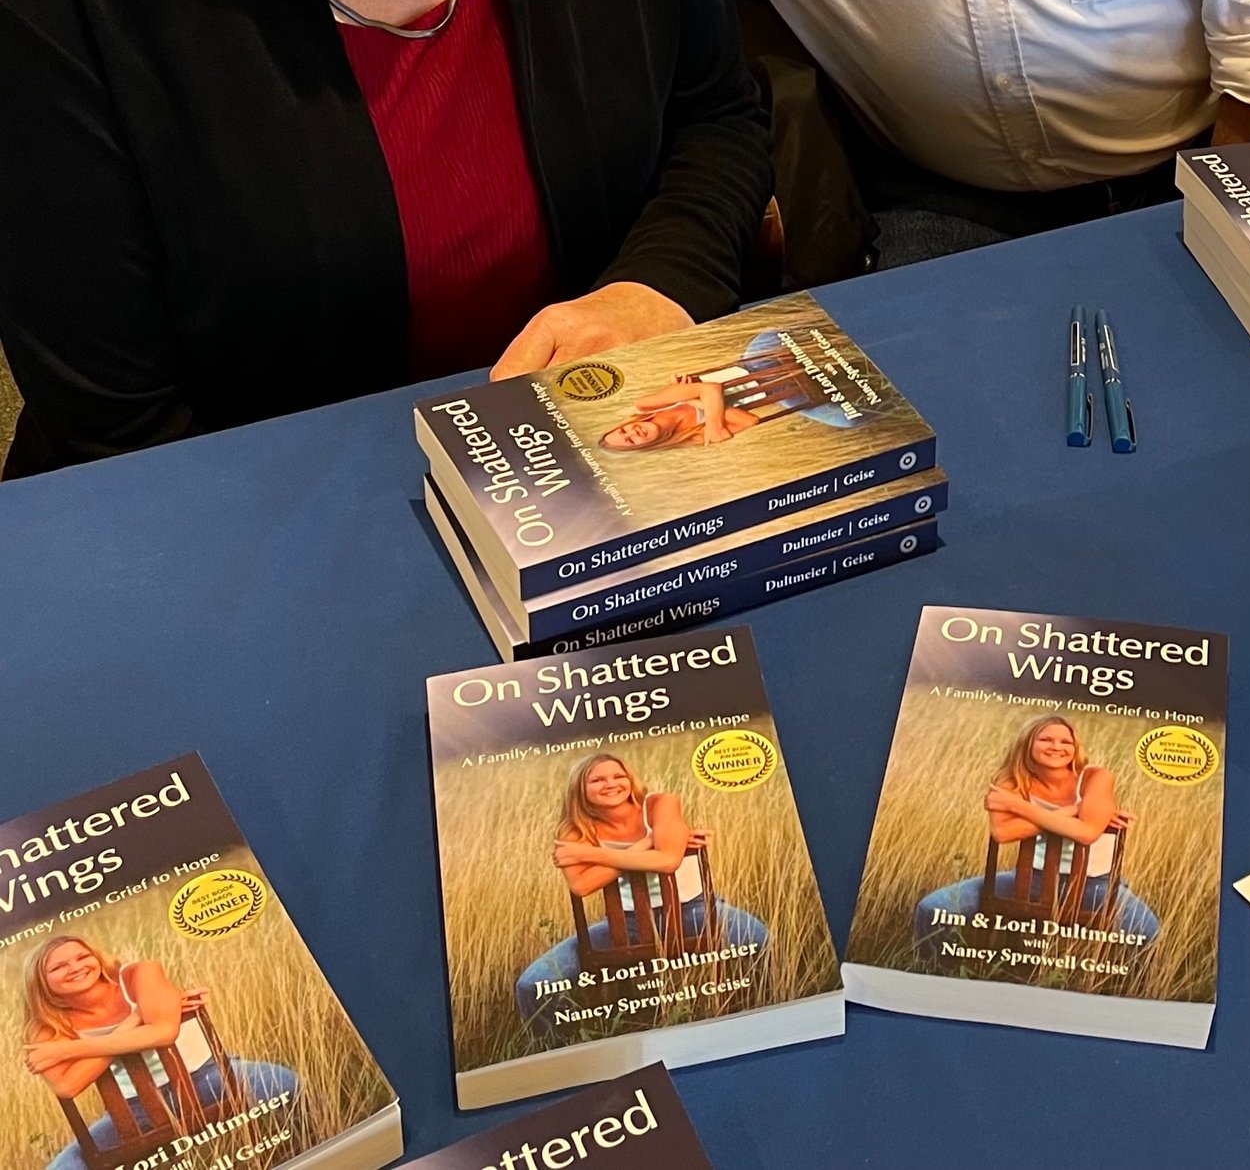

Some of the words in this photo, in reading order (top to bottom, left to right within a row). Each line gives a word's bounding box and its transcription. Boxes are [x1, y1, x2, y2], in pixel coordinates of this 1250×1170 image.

[558, 559, 586, 579] On
[591, 529, 669, 569] Shattered
[673, 515, 724, 542] Wings
[767, 478, 829, 512] Dultmeier
[843, 467, 875, 488] Geise
[940, 616, 1003, 644] On
[1017, 621, 1209, 666] Shattered
[453, 677, 521, 707] On
[536, 634, 738, 696] Shattered
[1006, 652, 1134, 697] Wings
[532, 684, 671, 728] Wings
[706, 755, 761, 771] WINNER
[1149, 750, 1202, 766] WINNER
[188, 892, 250, 926] WINNER
